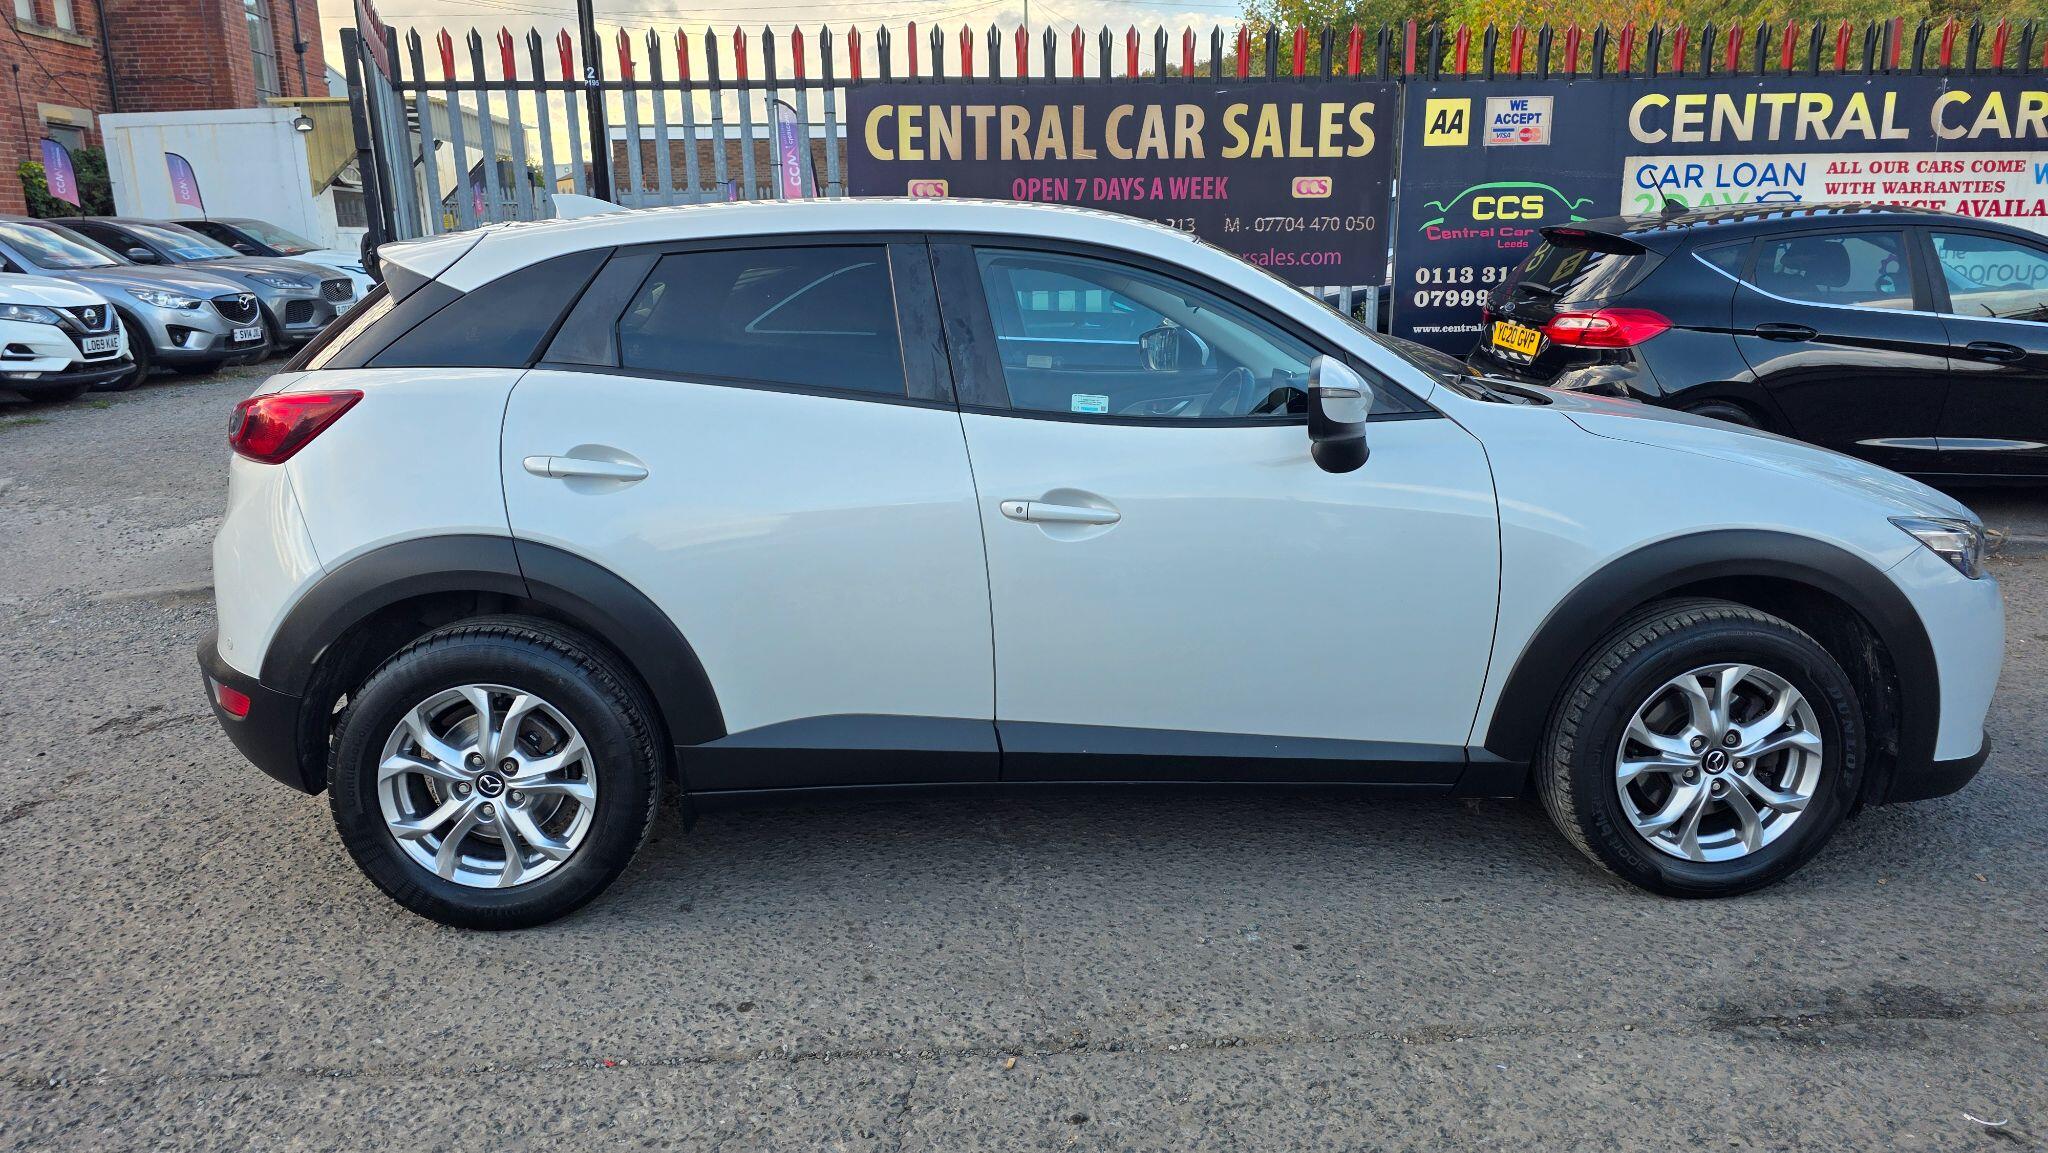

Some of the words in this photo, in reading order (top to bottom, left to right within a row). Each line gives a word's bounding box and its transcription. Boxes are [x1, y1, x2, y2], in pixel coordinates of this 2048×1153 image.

[586, 66, 596, 79] 2
[1510, 99, 1529, 112] WE
[1429, 108, 1464, 135] AA
[1494, 112, 1543, 125] ACCEPT
[1628, 90, 1910, 144] CENTRAL
[1929, 90, 2048, 140] CAR
[864, 104, 1098, 161] CENTRAL
[1104, 103, 1206, 160] CAR
[1221, 101, 1376, 159] SALES
[1636, 163, 1705, 189] CAR
[1715, 161, 1807, 188] LOAN
[1826, 160, 1862, 175] ALL
[1869, 160, 1910, 174] OUR
[1916, 160, 1965, 173] CARS
[1970, 159, 2027, 173] COME
[1012, 176, 1068, 201] OPEN
[1074, 178, 1088, 201] 7
[1093, 176, 1145, 201] DAYS
[1150, 176, 1164, 201] A
[1168, 176, 1230, 200] WEEK
[1825, 181, 1875, 195] WITH
[1882, 180, 2006, 194] WARRANTIES
[1472, 195, 1544, 221] CCS
[1224, 217, 1240, 233] M
[1254, 216, 1304, 232] 07704
[1310, 216, 1340, 232] 470
[1345, 216, 1376, 231] 050
[1426, 225, 1495, 241] Central
[1499, 227, 1535, 237] Car
[1497, 239, 1529, 248] Leeds
[1415, 266, 1474, 285] 0113
[1481, 266, 1518, 284] 31
[1413, 289, 1489, 308] 07999
[1413, 323, 1484, 334] www.central
[1497, 323, 1517, 345] YC20
[105, 337, 118, 349] KAE
